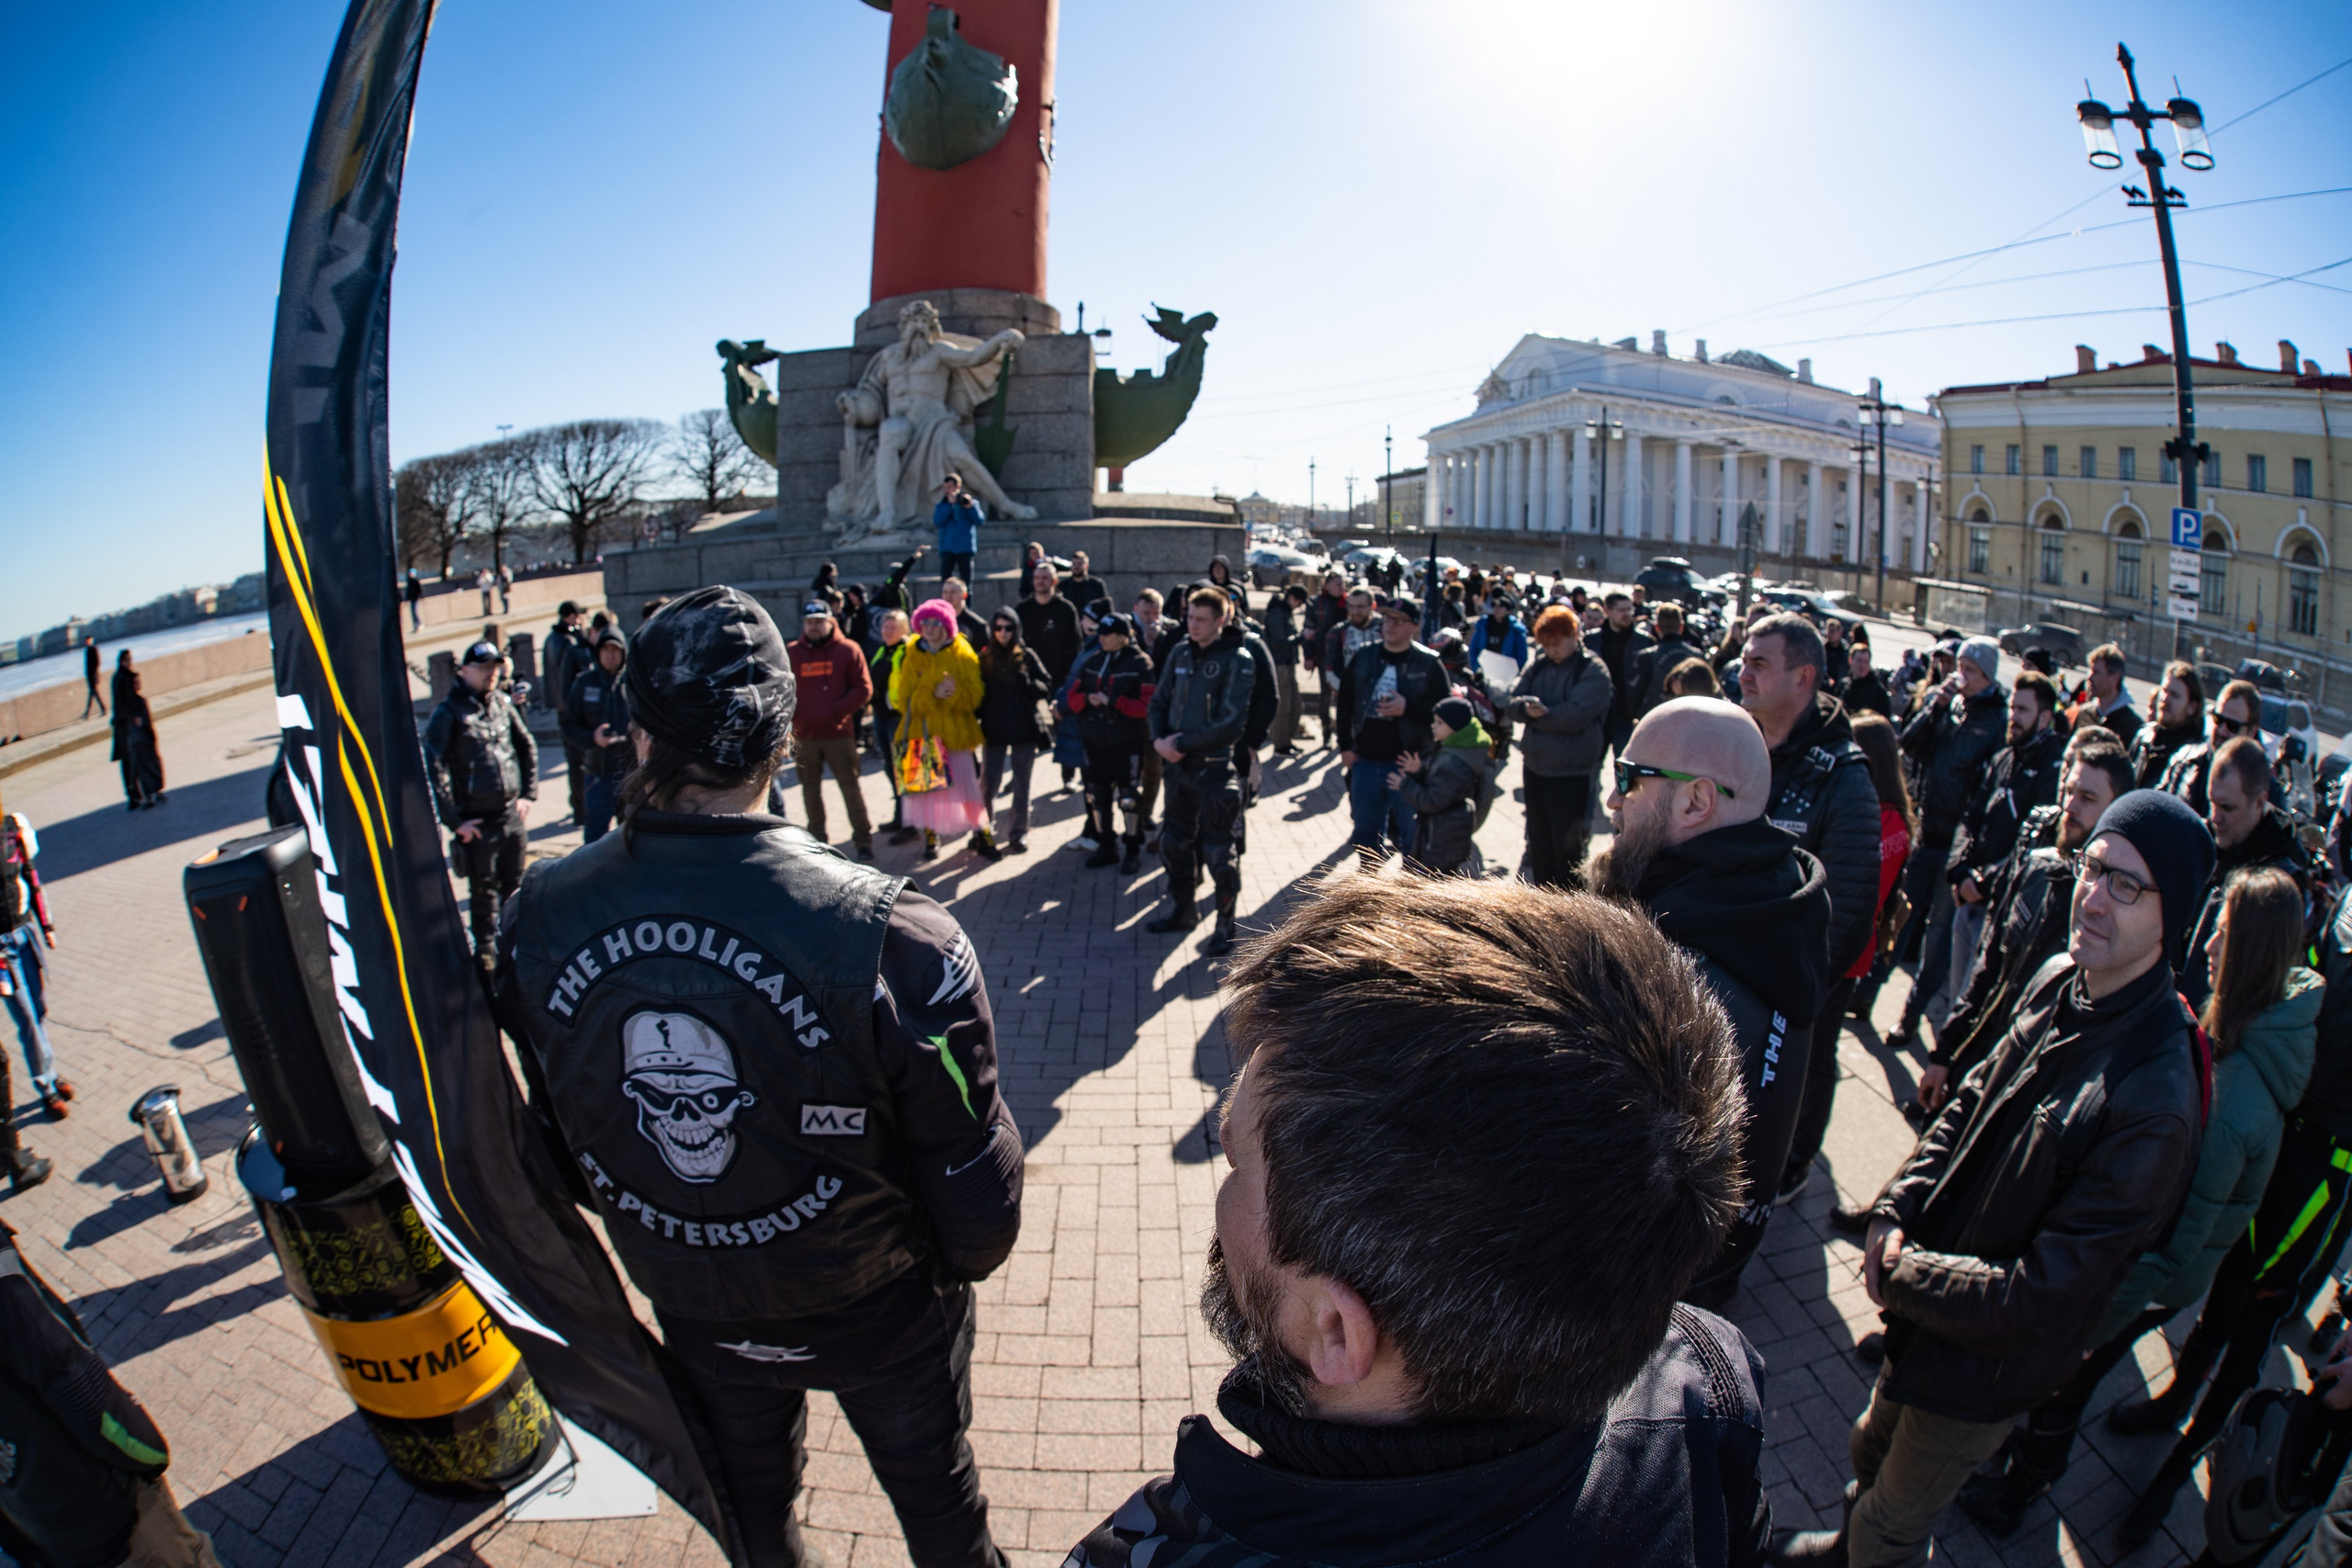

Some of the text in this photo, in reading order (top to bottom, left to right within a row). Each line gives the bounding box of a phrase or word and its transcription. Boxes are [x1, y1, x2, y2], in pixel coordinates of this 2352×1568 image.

[2178, 513, 2198, 544] P
[547, 920, 830, 1048] THE HOOLIGANS
[1761, 1010, 1787, 1088] THE
[804, 1110, 863, 1131] MC
